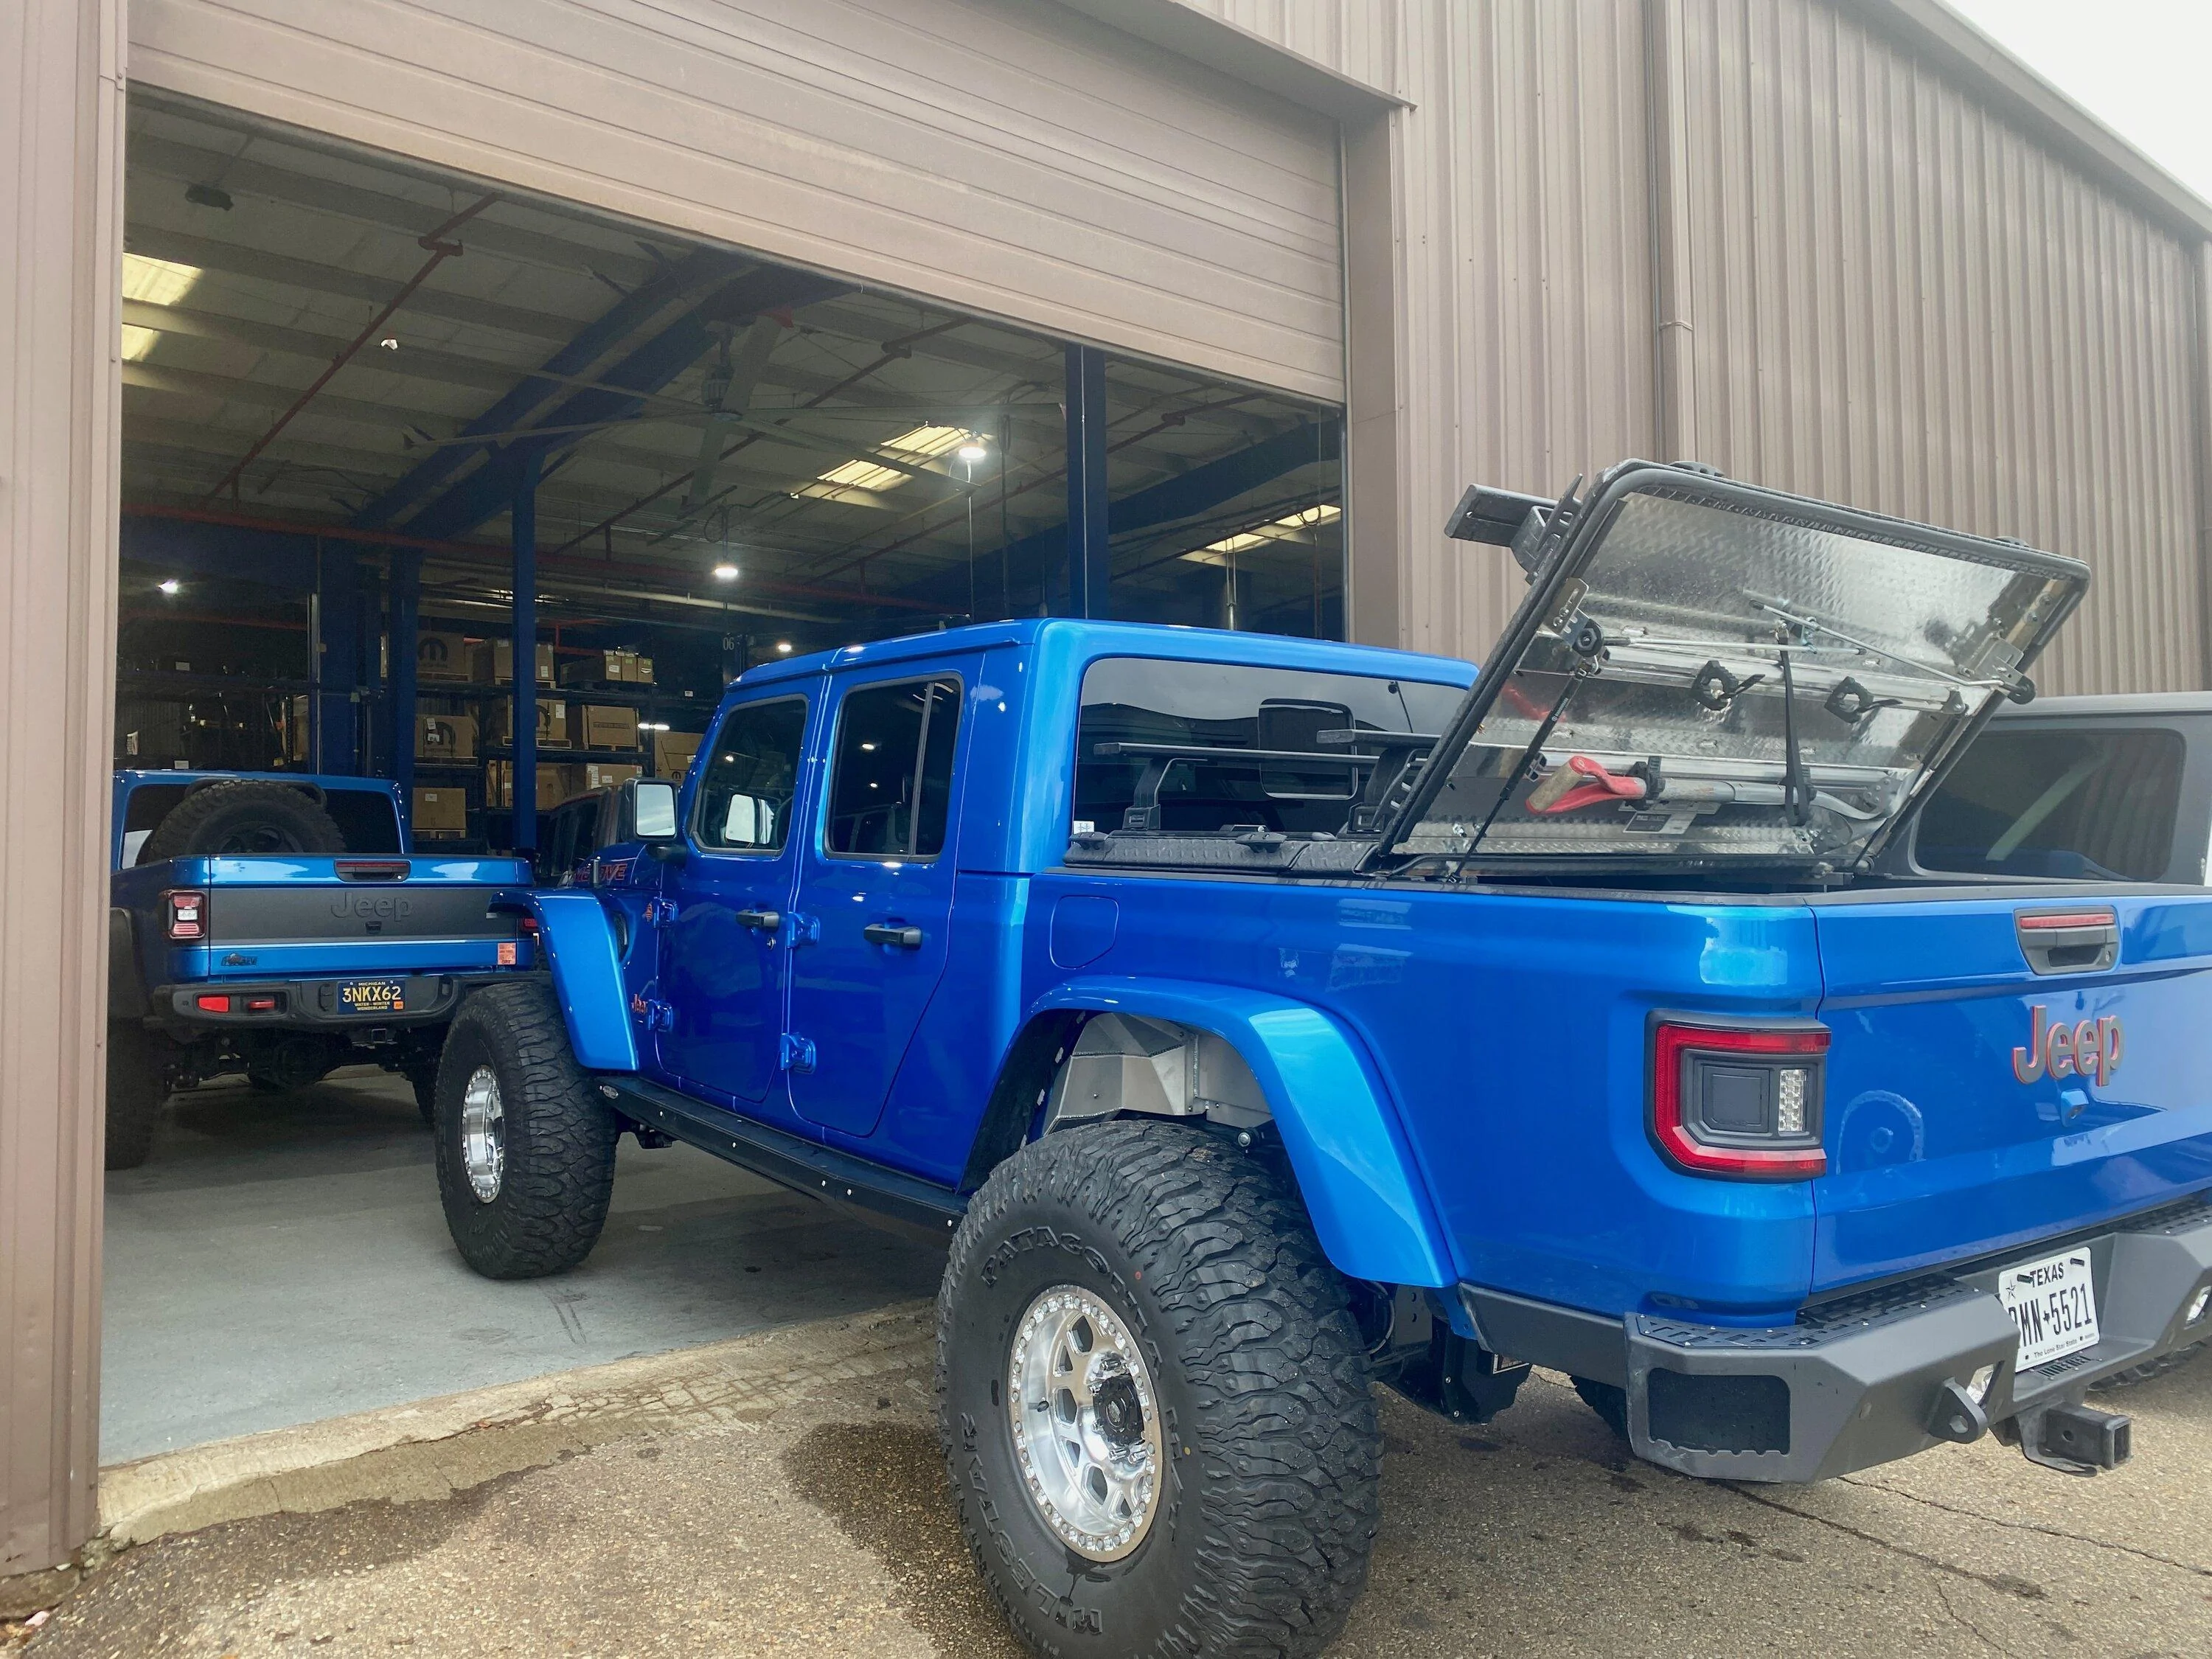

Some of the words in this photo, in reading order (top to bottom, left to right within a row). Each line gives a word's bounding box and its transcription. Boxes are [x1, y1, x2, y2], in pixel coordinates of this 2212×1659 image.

[723, 637, 734, 650] 06
[330, 891, 414, 922] Jeep
[342, 986, 401, 1003] 3NKX62
[2012, 1005, 2125, 1087] Jeep
[2029, 1262, 2065, 1288] TEXAS
